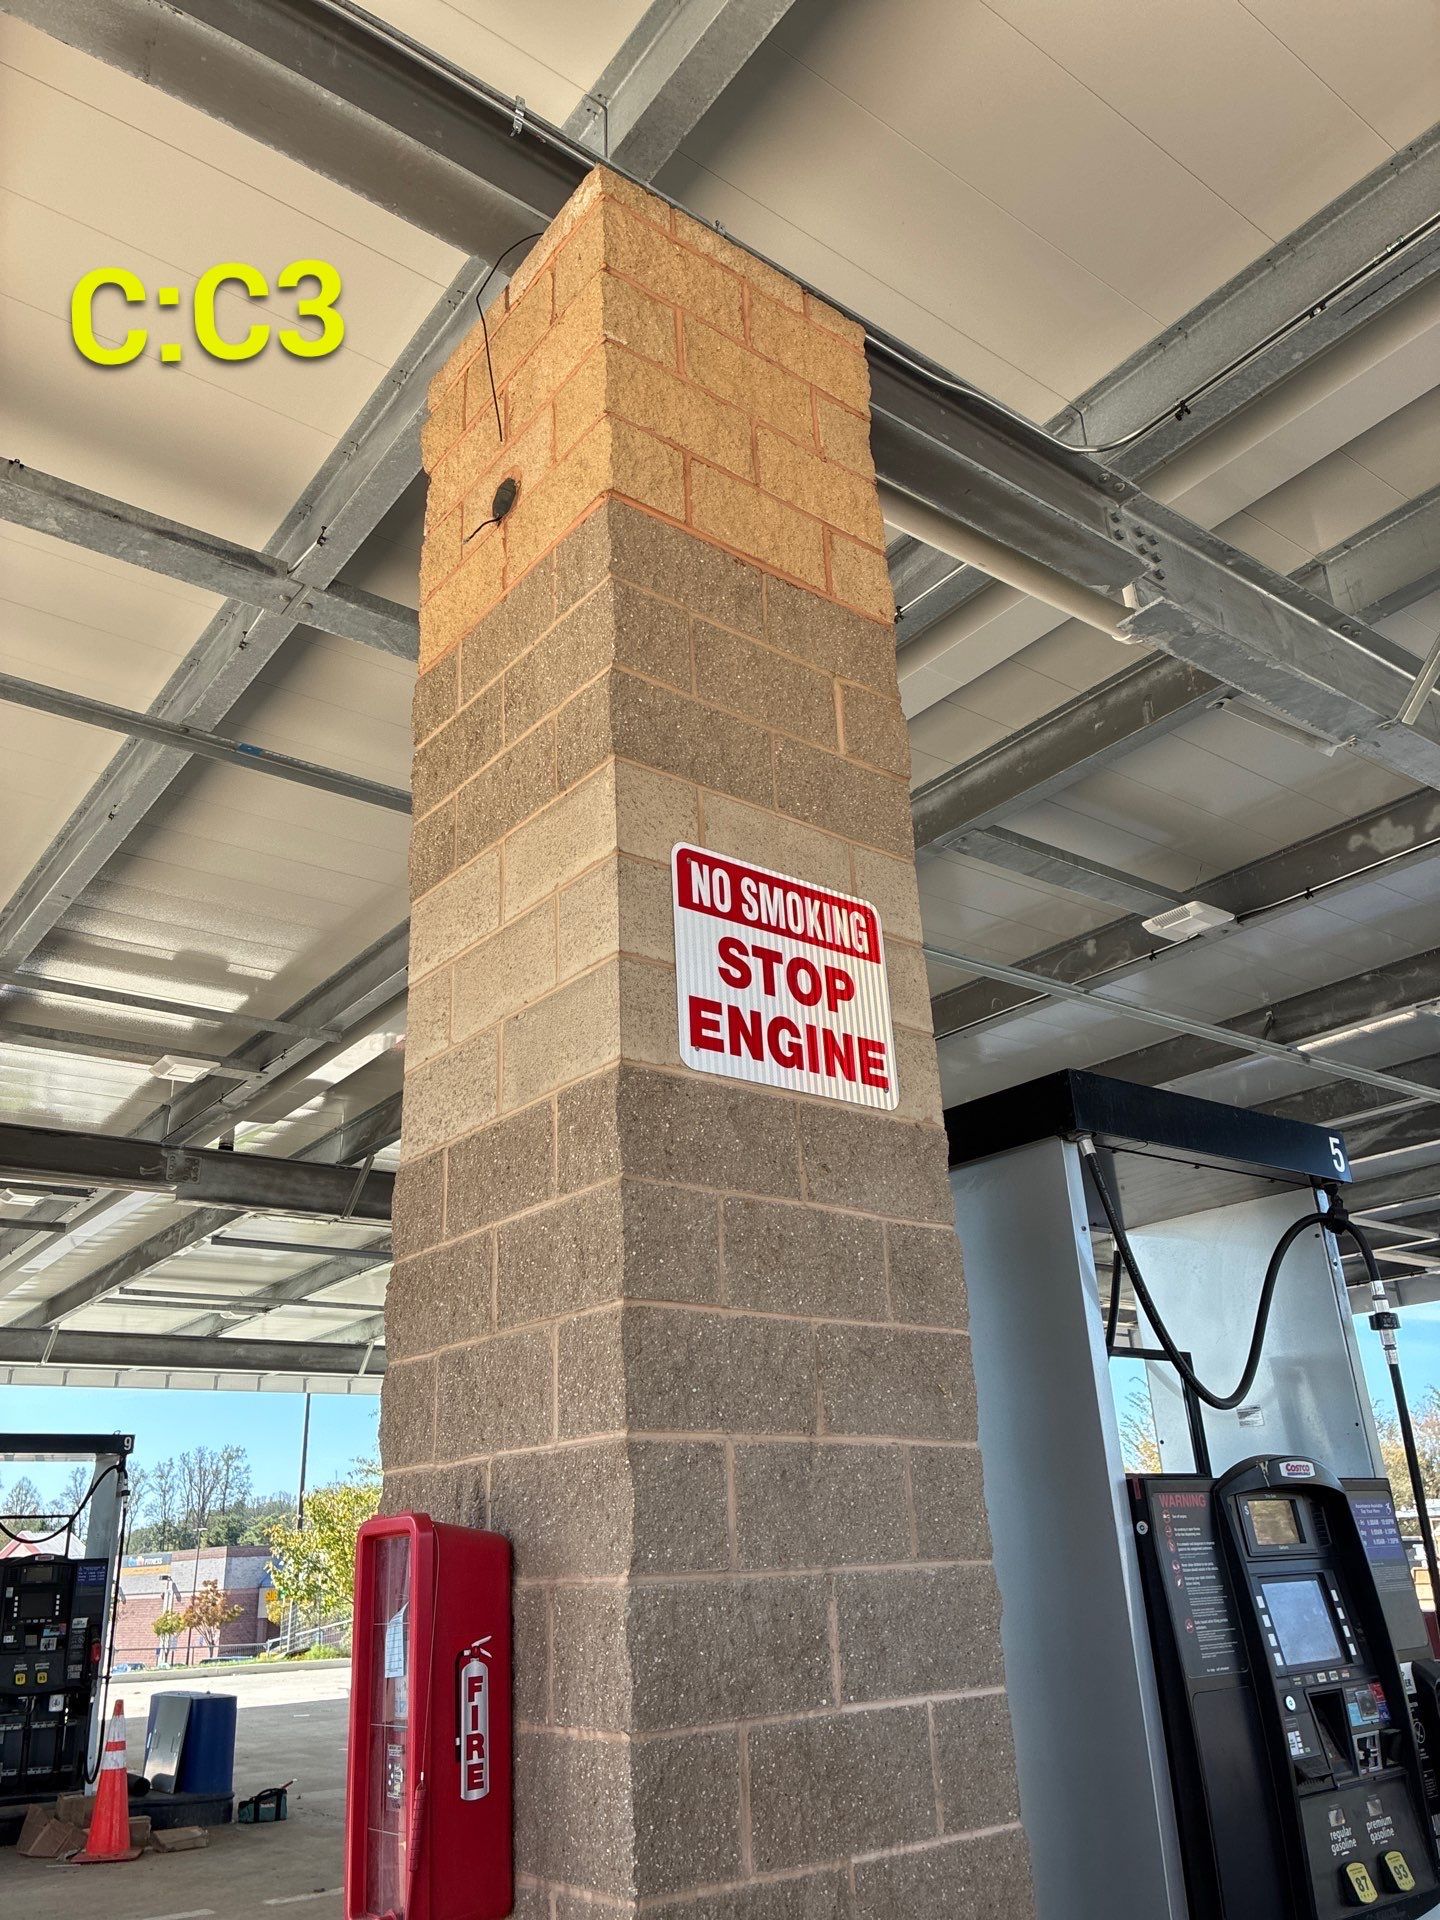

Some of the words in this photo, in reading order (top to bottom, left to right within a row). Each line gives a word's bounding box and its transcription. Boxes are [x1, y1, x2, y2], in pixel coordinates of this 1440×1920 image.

[690, 860, 731, 913] NO
[740, 877, 870, 955] SMOKING
[717, 936, 855, 1013] STOP
[688, 994, 890, 1089] ENGINE
[1328, 1136, 1346, 1173] 5
[123, 1436, 132, 1451] 9
[1158, 1493, 1207, 1508] WARNING
[466, 1676, 484, 1791] FIRE
[1329, 1825, 1352, 1842] regular
[1366, 1816, 1393, 1833] premium
[1370, 1827, 1395, 1845] gasoline
[1331, 1838, 1357, 1856] gasoline
[1393, 1864, 1409, 1880] 93
[1355, 1875, 1370, 1893] 87
